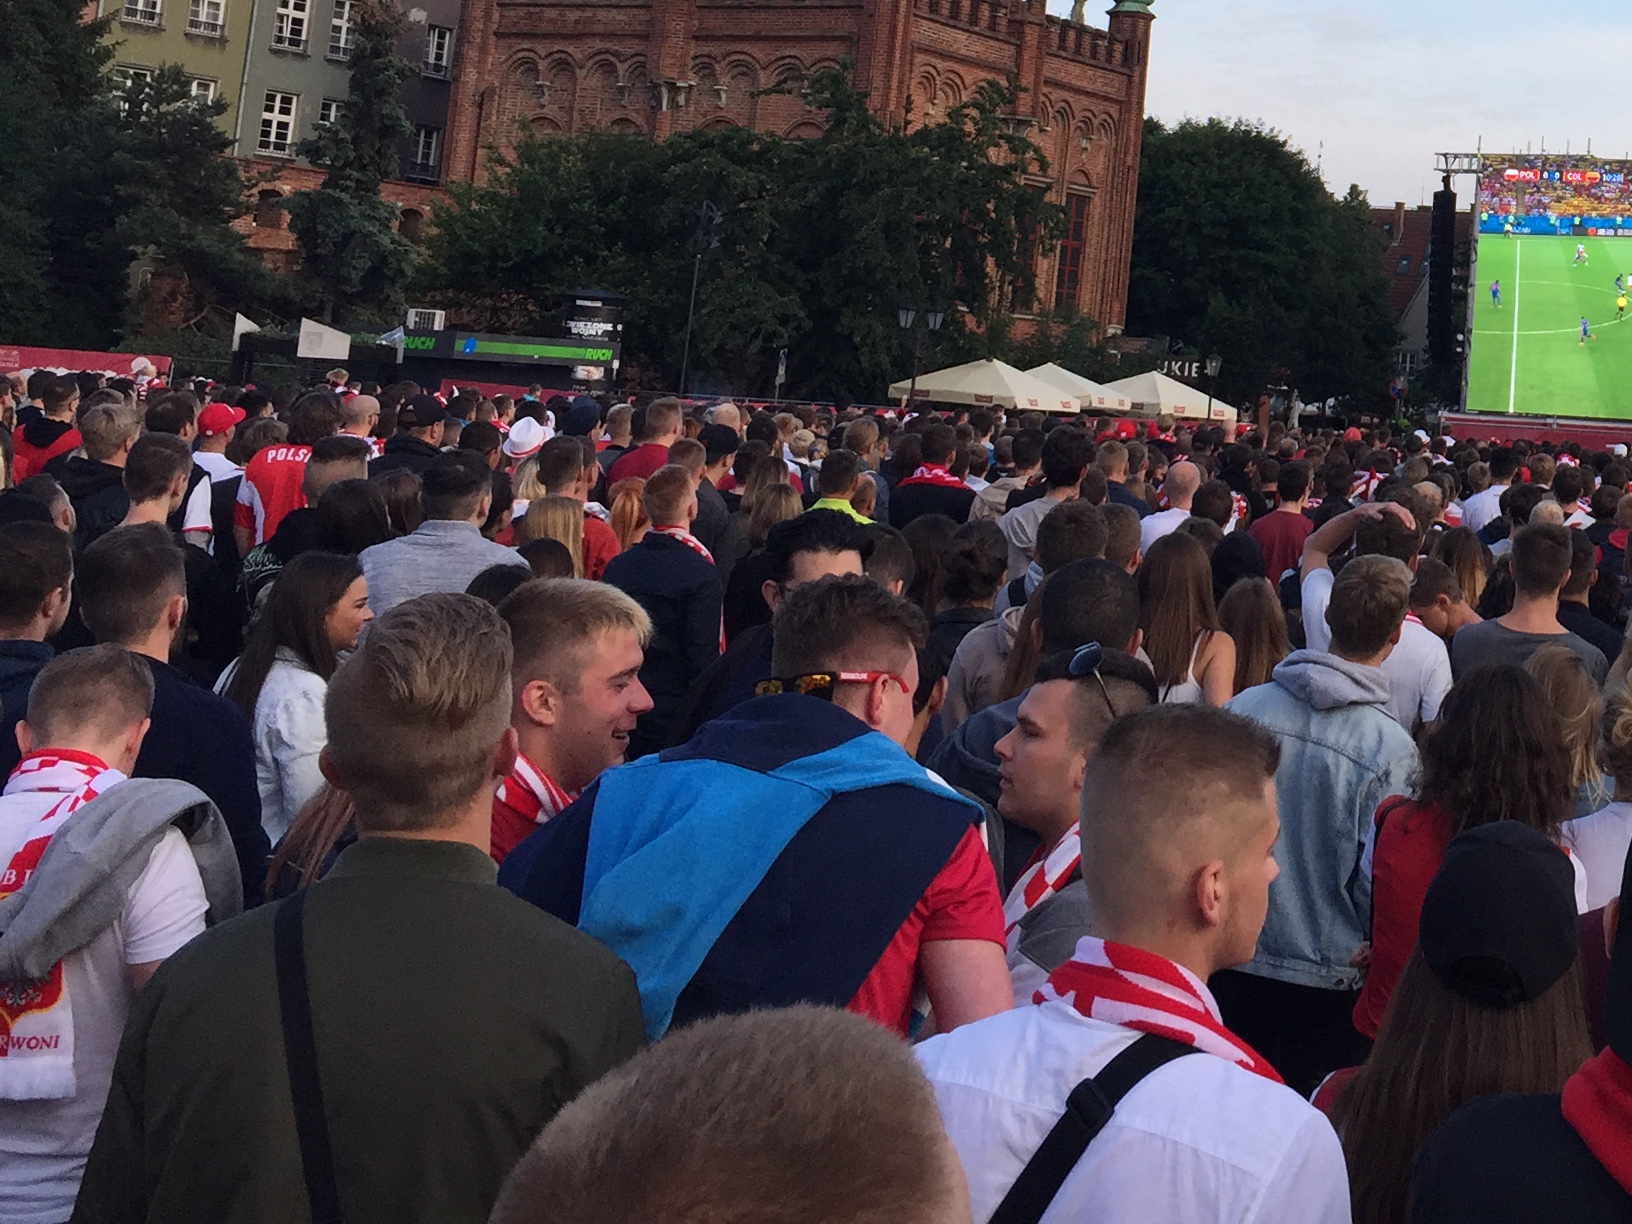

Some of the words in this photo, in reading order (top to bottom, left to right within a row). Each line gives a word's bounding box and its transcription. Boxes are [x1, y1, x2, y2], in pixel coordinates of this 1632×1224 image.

[1520, 171, 1535, 179] POL
[1567, 172, 1582, 180] COL
[585, 348, 613, 361] RUCH
